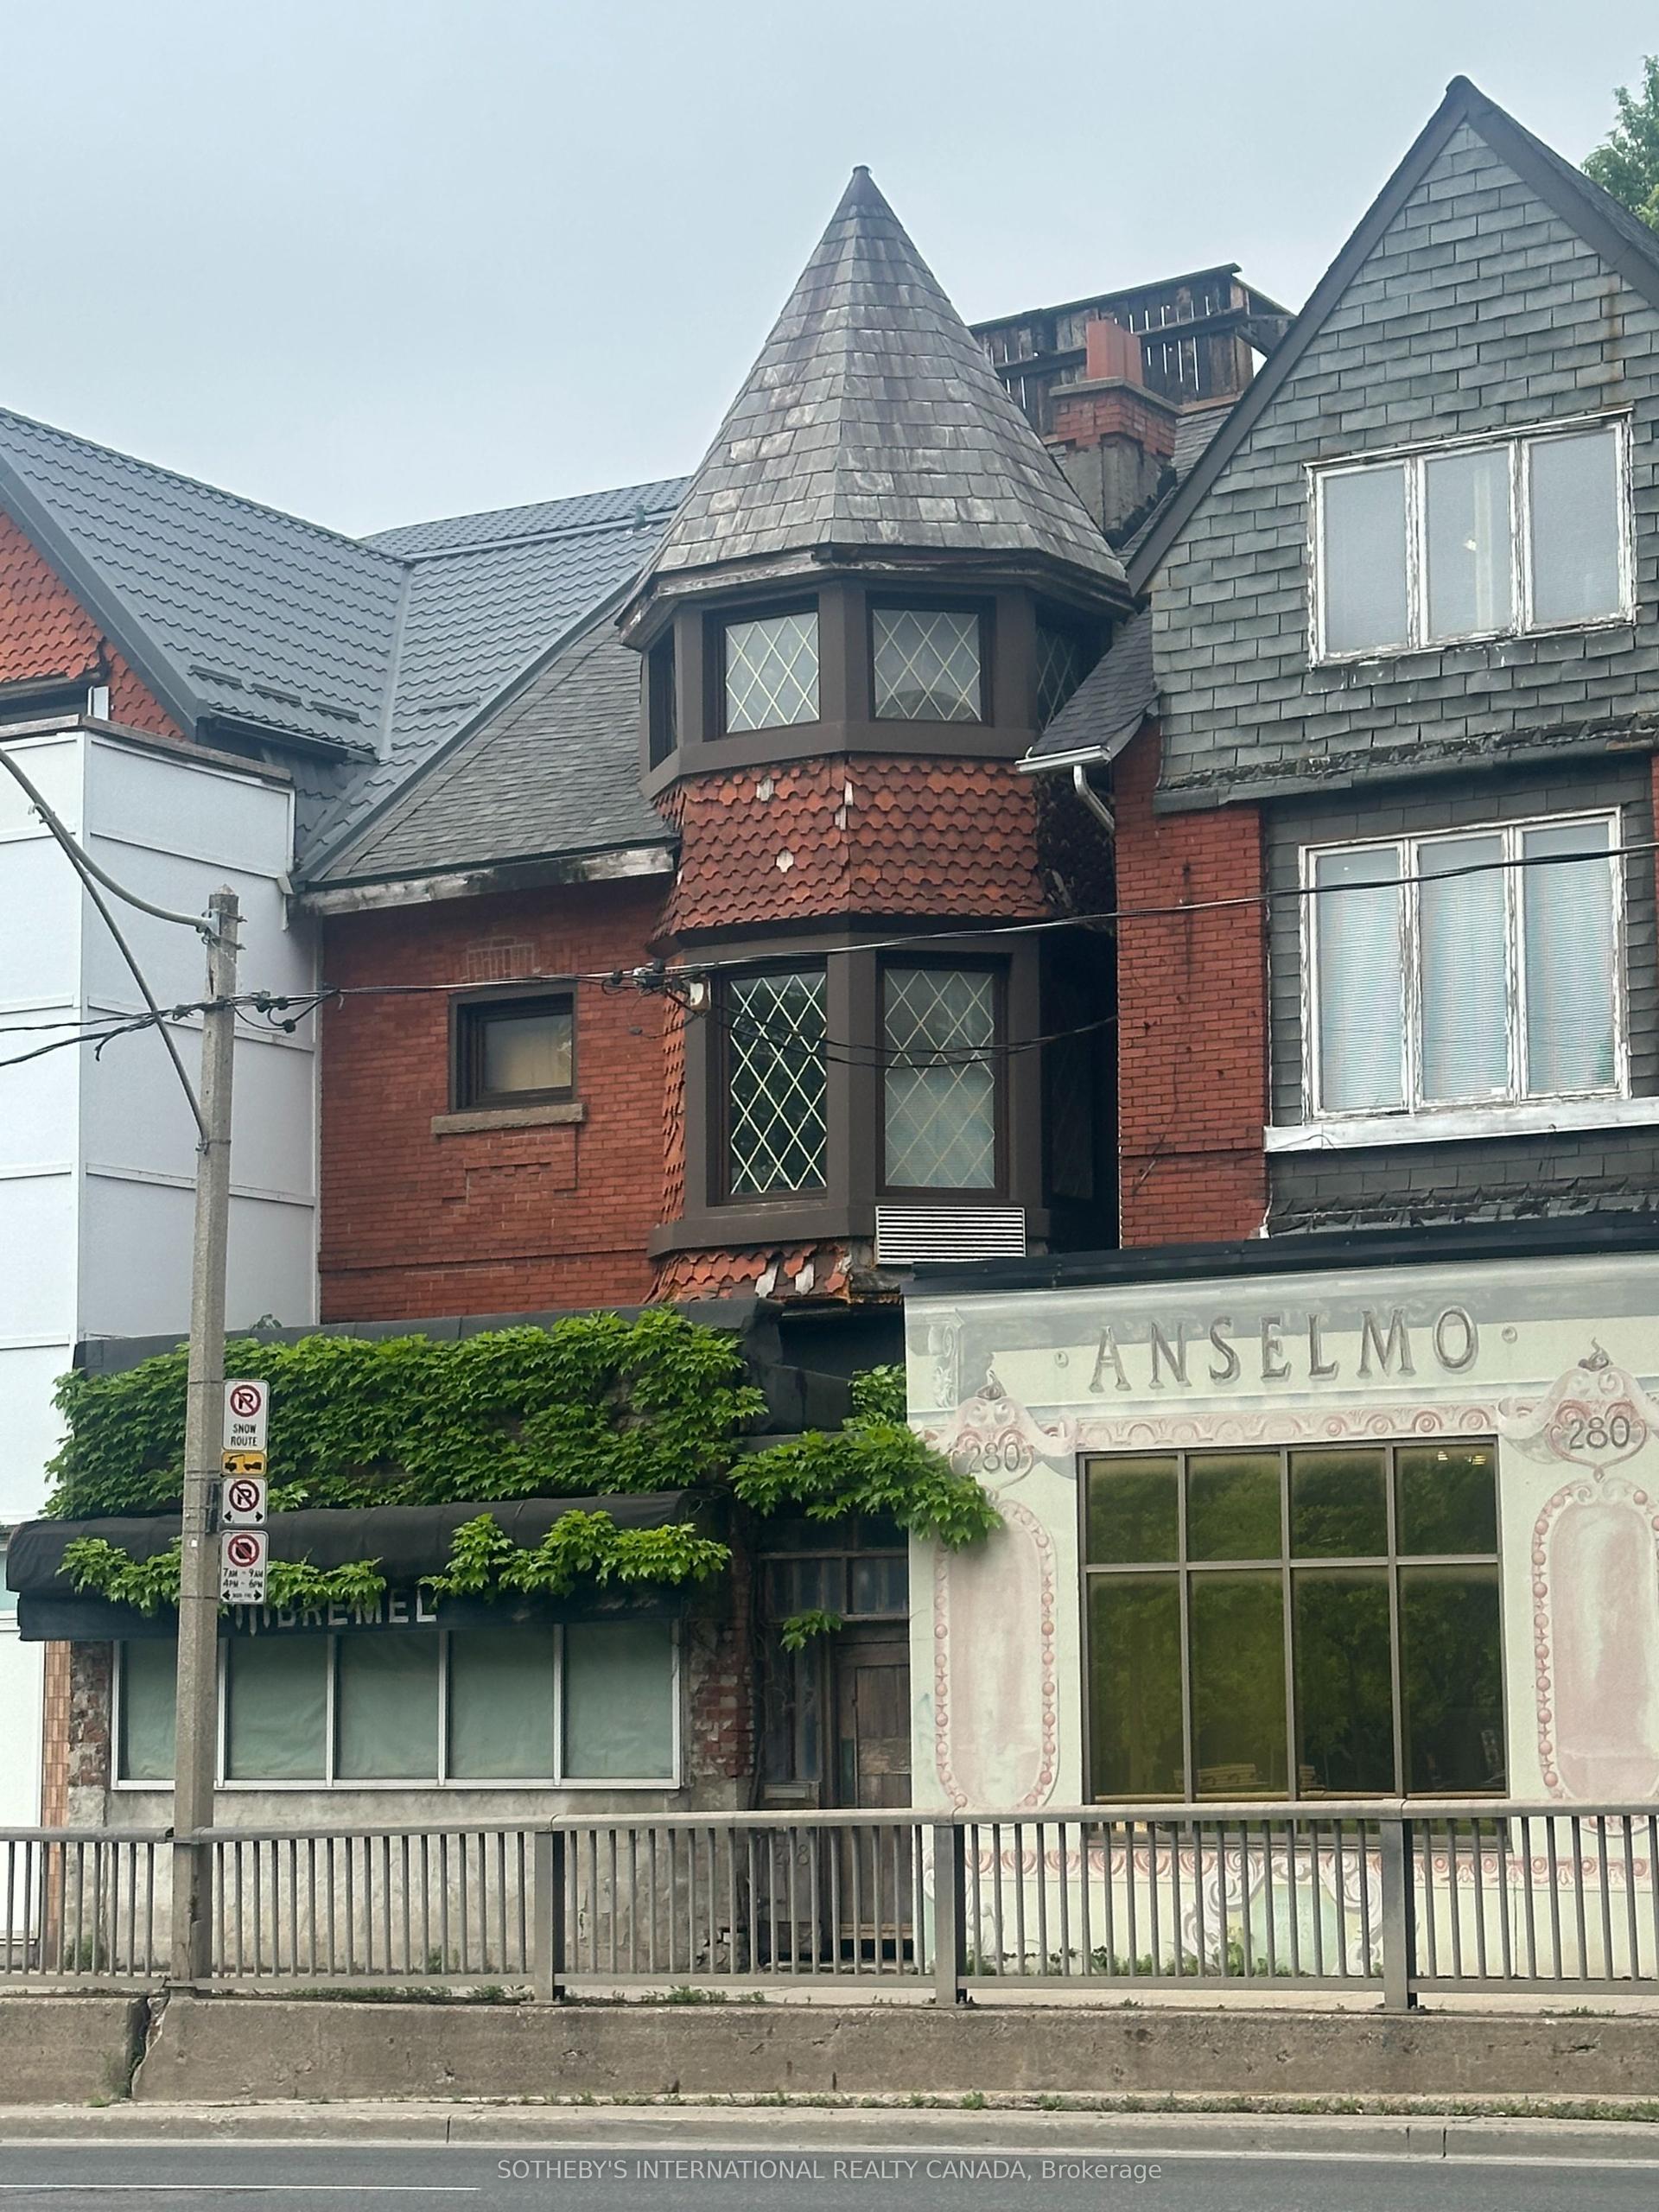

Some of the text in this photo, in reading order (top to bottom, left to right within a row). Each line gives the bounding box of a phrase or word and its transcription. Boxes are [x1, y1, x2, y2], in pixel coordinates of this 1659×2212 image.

[1089, 1306, 1479, 1393] ANSELMO
[232, 1424, 257, 1433] SNOW
[1569, 1416, 1630, 1450] 280
[231, 1436, 257, 1446] ROUTE
[968, 1442, 1020, 1473] 280
[223, 1567, 238, 1578] 7AM
[249, 1568, 264, 1578] 9AM
